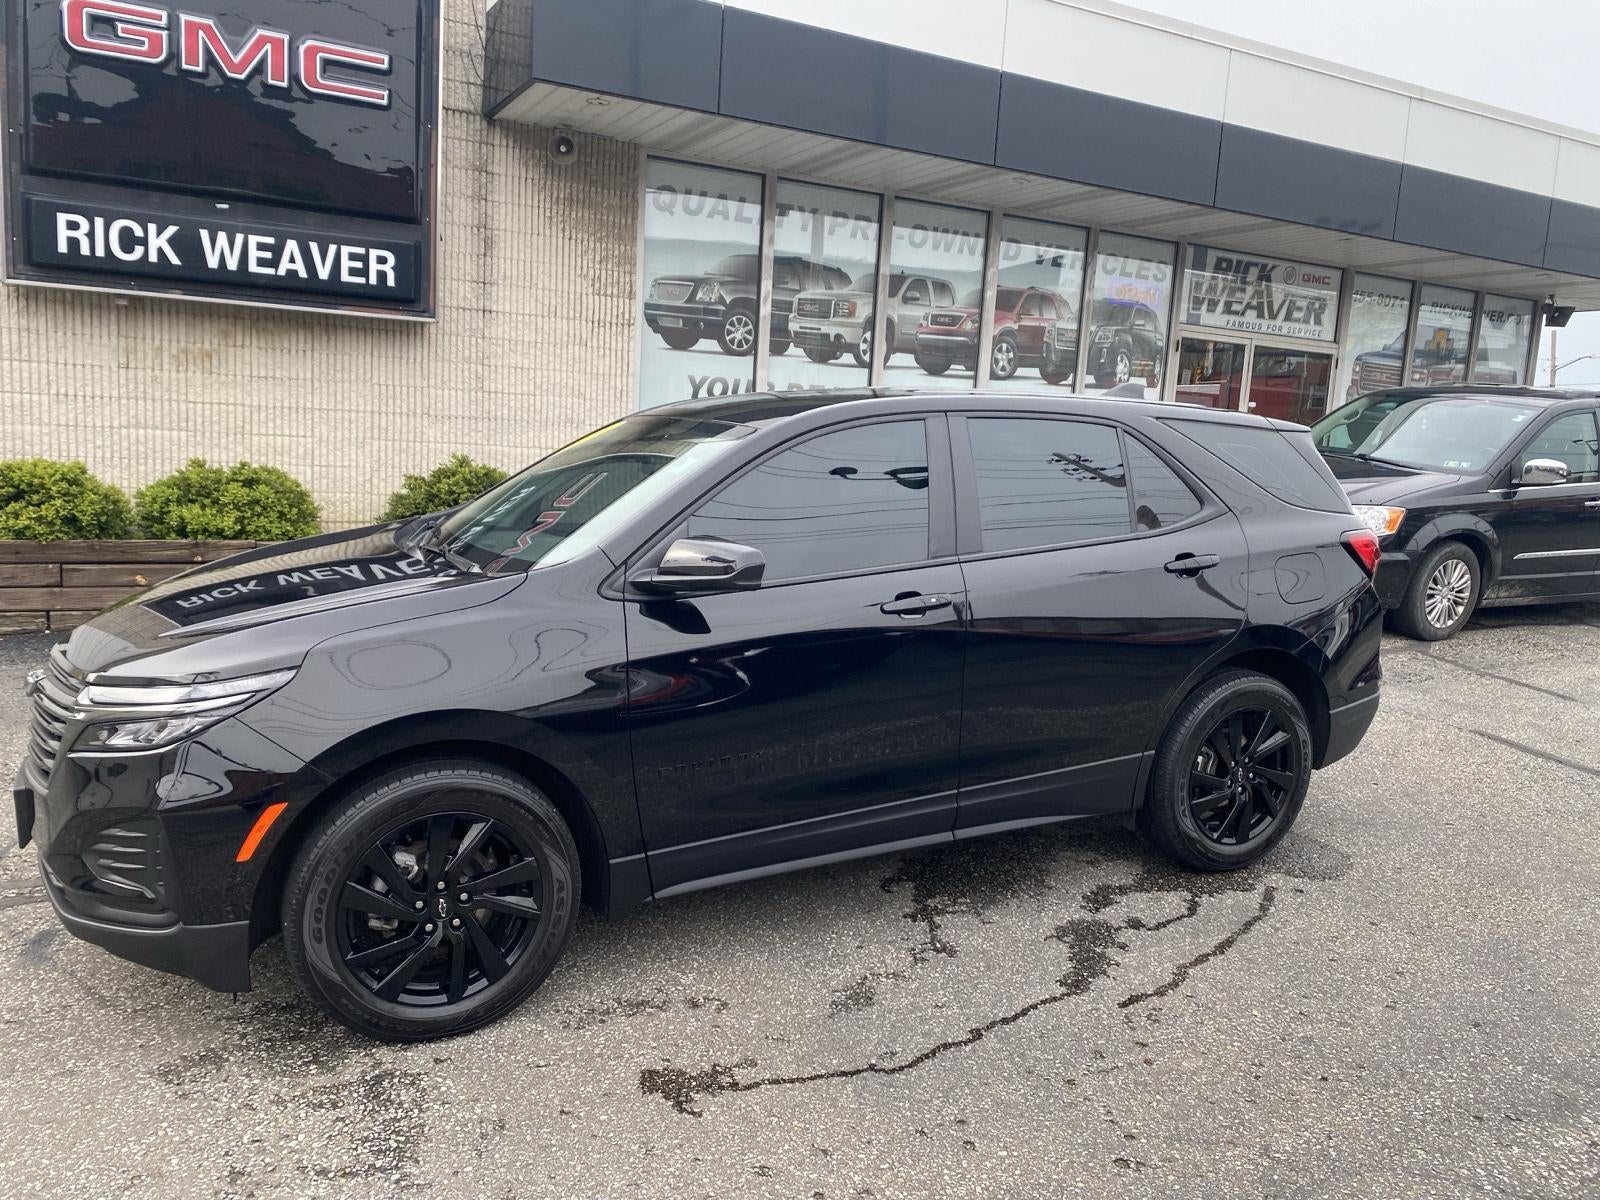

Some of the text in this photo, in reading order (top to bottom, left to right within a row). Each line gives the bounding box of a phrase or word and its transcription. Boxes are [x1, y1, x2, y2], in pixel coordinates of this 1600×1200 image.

[60, 0, 391, 106] GMC
[56, 212, 397, 288] RICK WEAVER
[652, 184, 1170, 283] QUALTY PR-OWND VEHCLES
[1210, 256, 1280, 286] RICK
[1302, 273, 1331, 286] GMC
[1111, 283, 1159, 304] OPEN
[1193, 280, 1328, 327] WEAVER
[1226, 319, 1323, 338] FAMOUS FOR SERVICE
